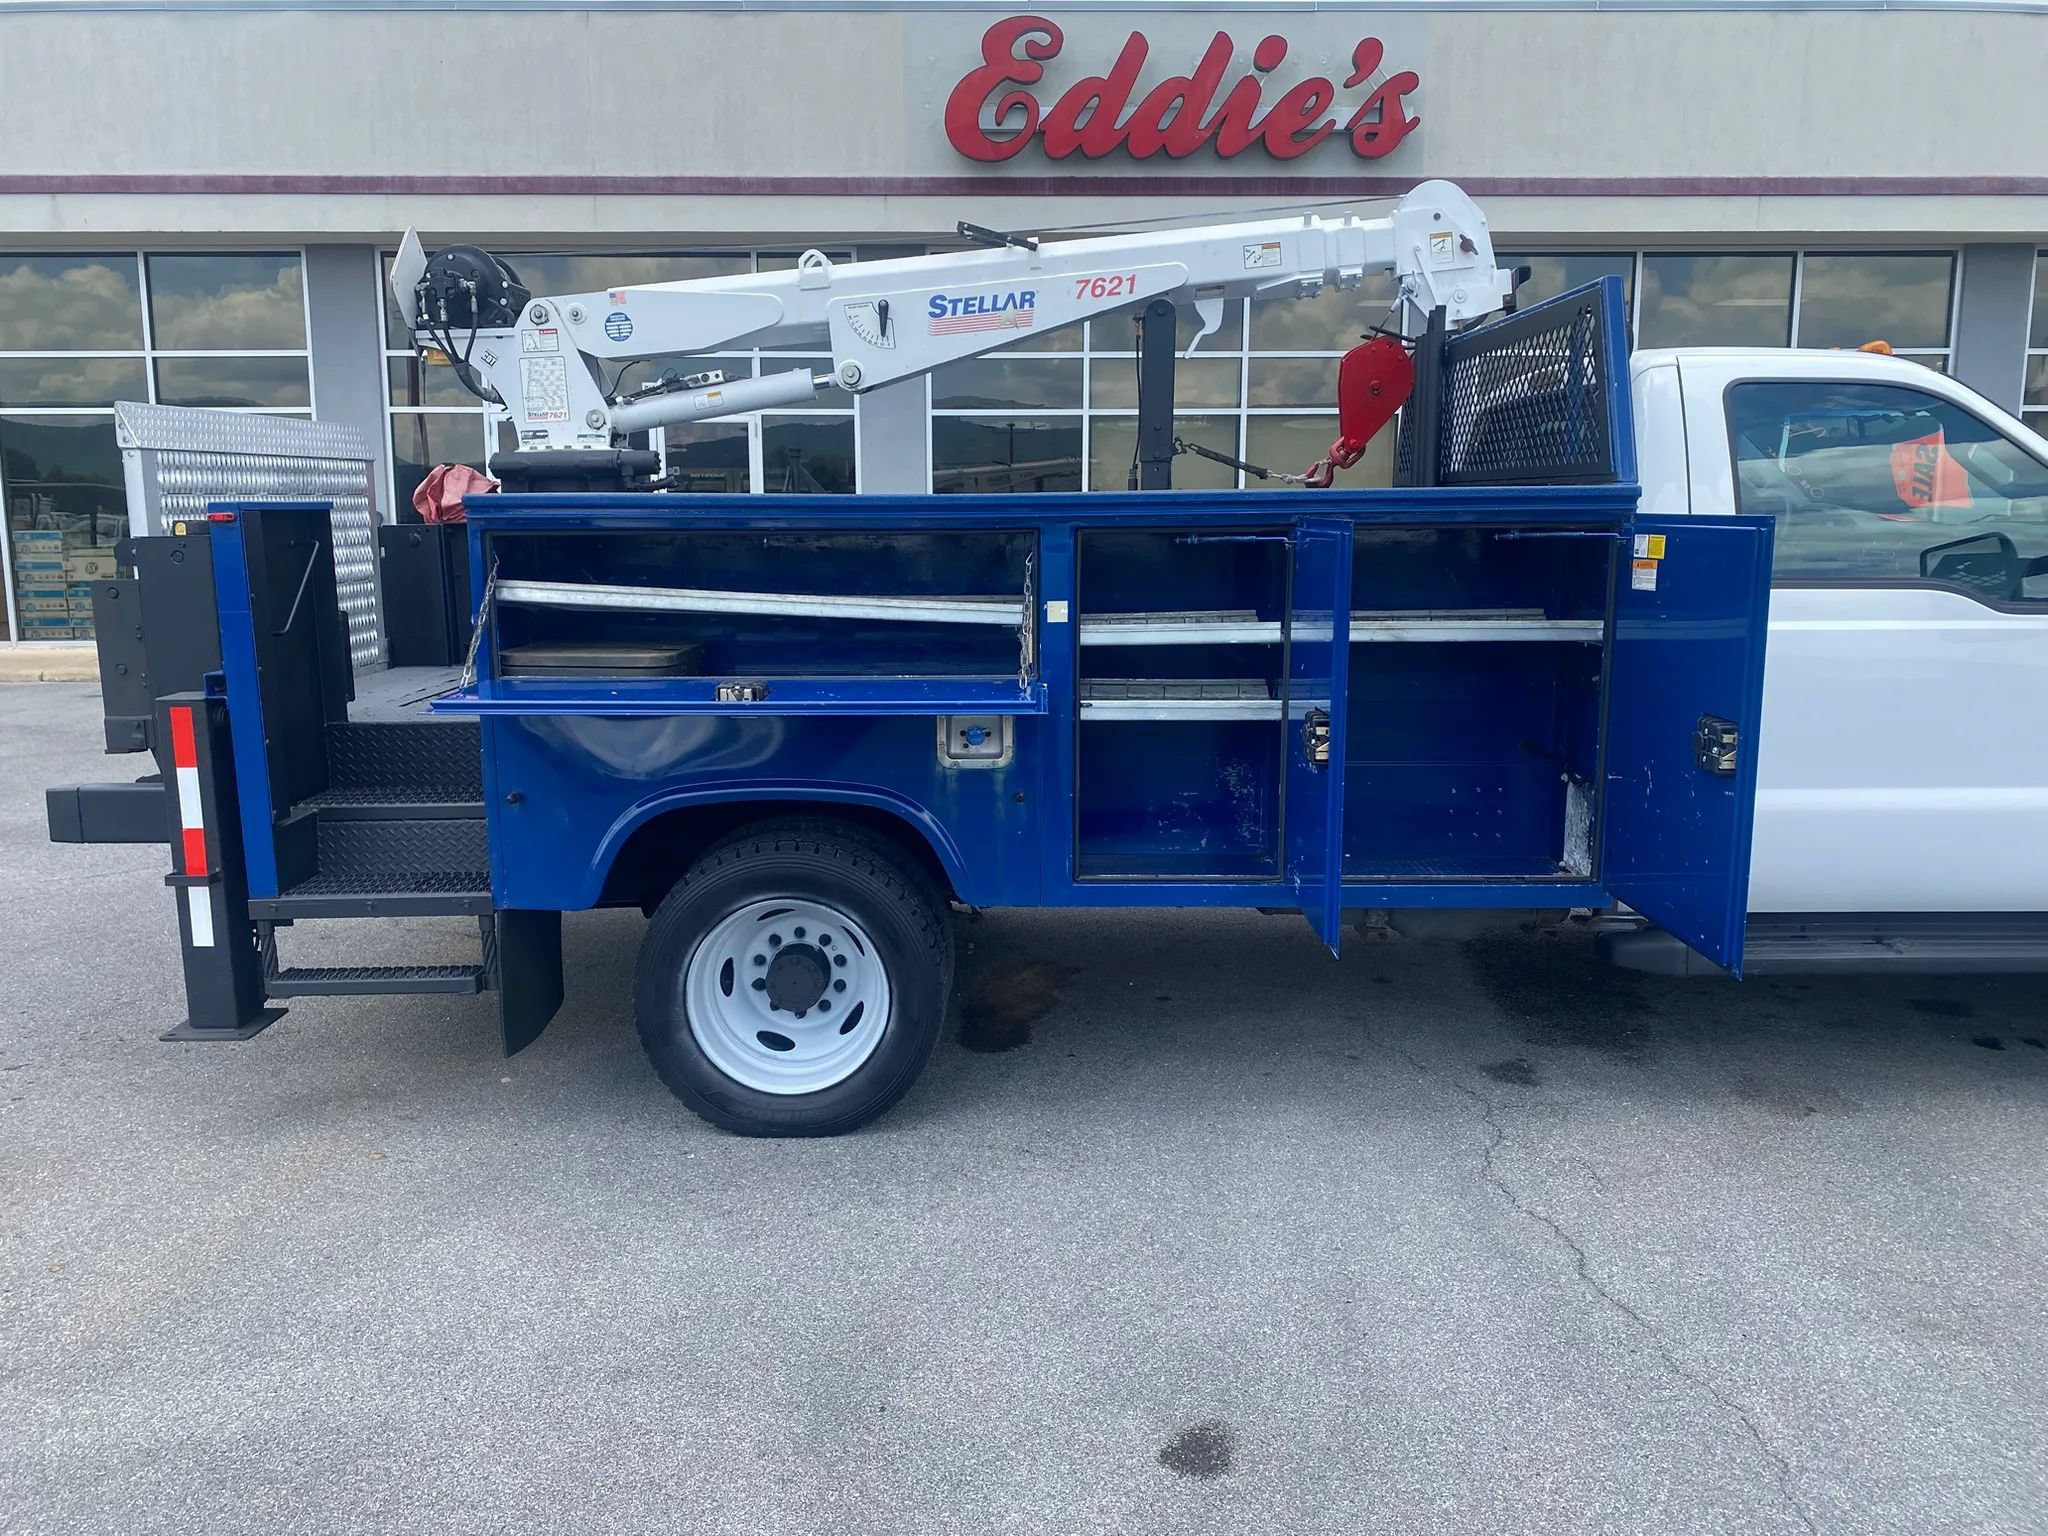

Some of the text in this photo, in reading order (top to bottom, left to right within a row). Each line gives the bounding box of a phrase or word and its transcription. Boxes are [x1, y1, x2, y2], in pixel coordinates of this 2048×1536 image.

[945, 15, 1421, 162] Eddie's
[1075, 274, 1137, 300] 7621
[928, 290, 1036, 319] STELLAR
